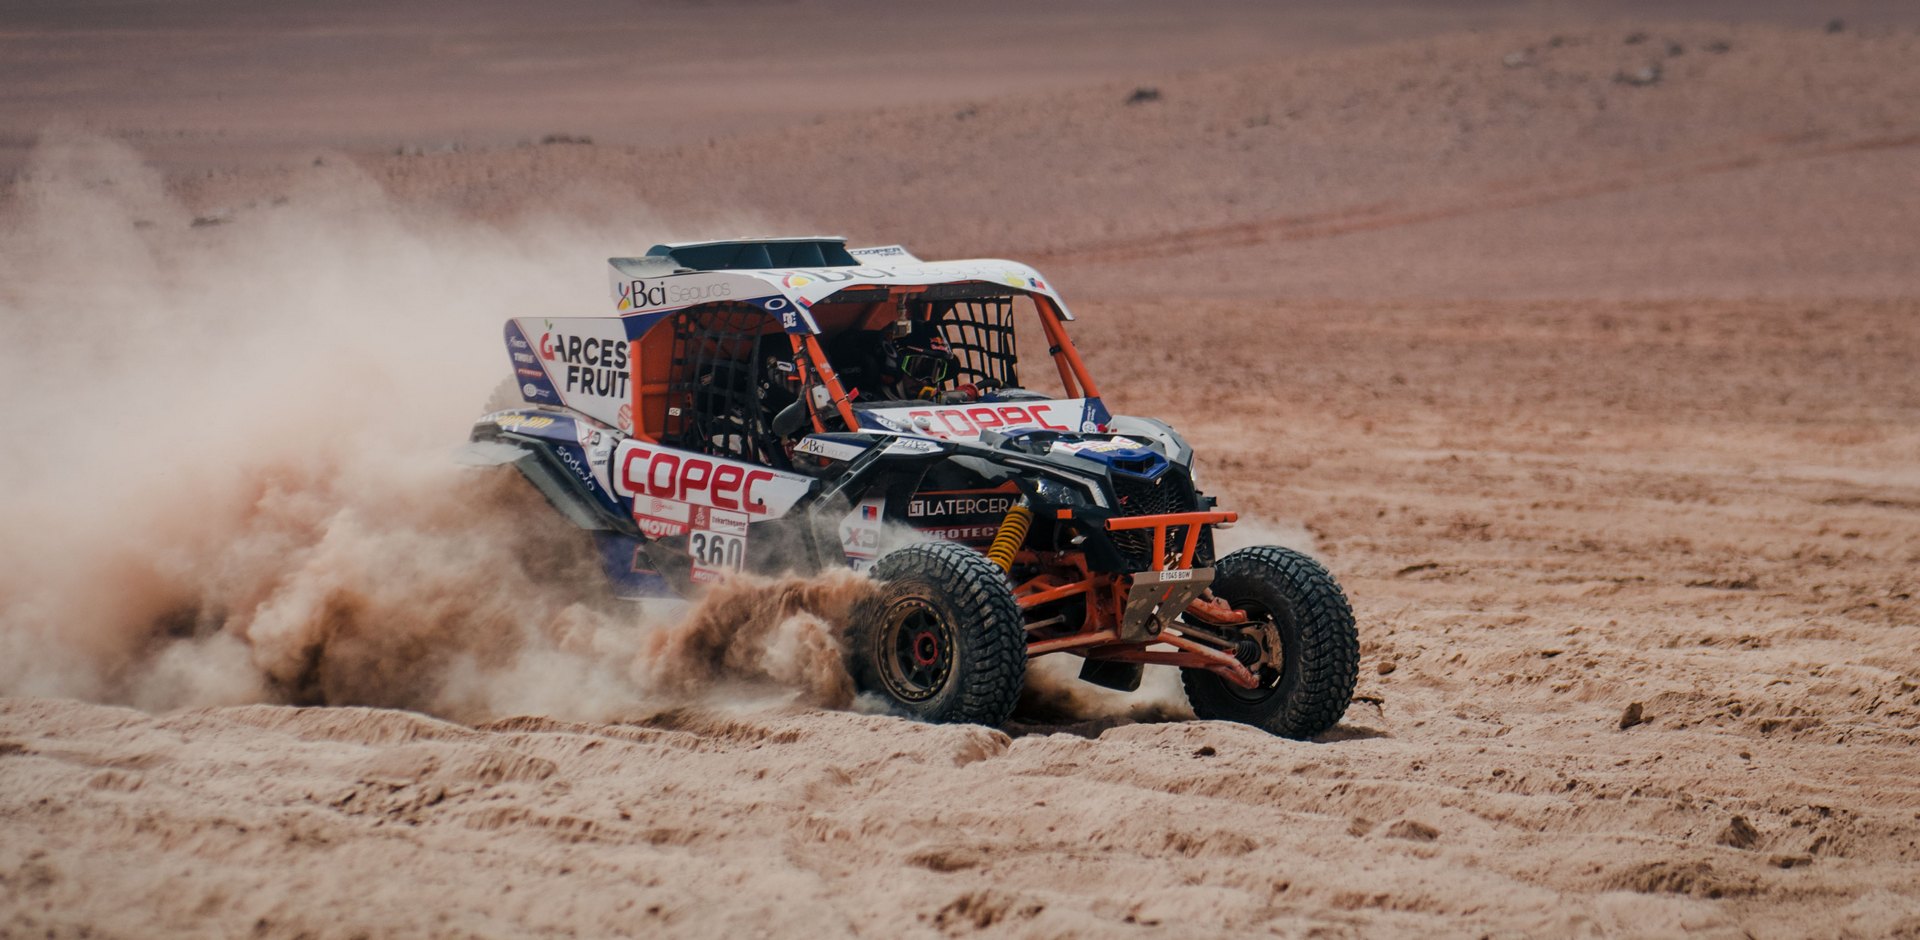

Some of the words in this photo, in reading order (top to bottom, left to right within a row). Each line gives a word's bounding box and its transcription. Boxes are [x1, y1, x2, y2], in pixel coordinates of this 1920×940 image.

[631, 280, 666, 309] Bci
[669, 282, 732, 305] Seguros
[539, 332, 628, 369] GARCES
[566, 365, 629, 399] FRUIT
[809, 439, 824, 454] Bci
[908, 500, 924, 517] LT
[692, 533, 743, 575] 360
